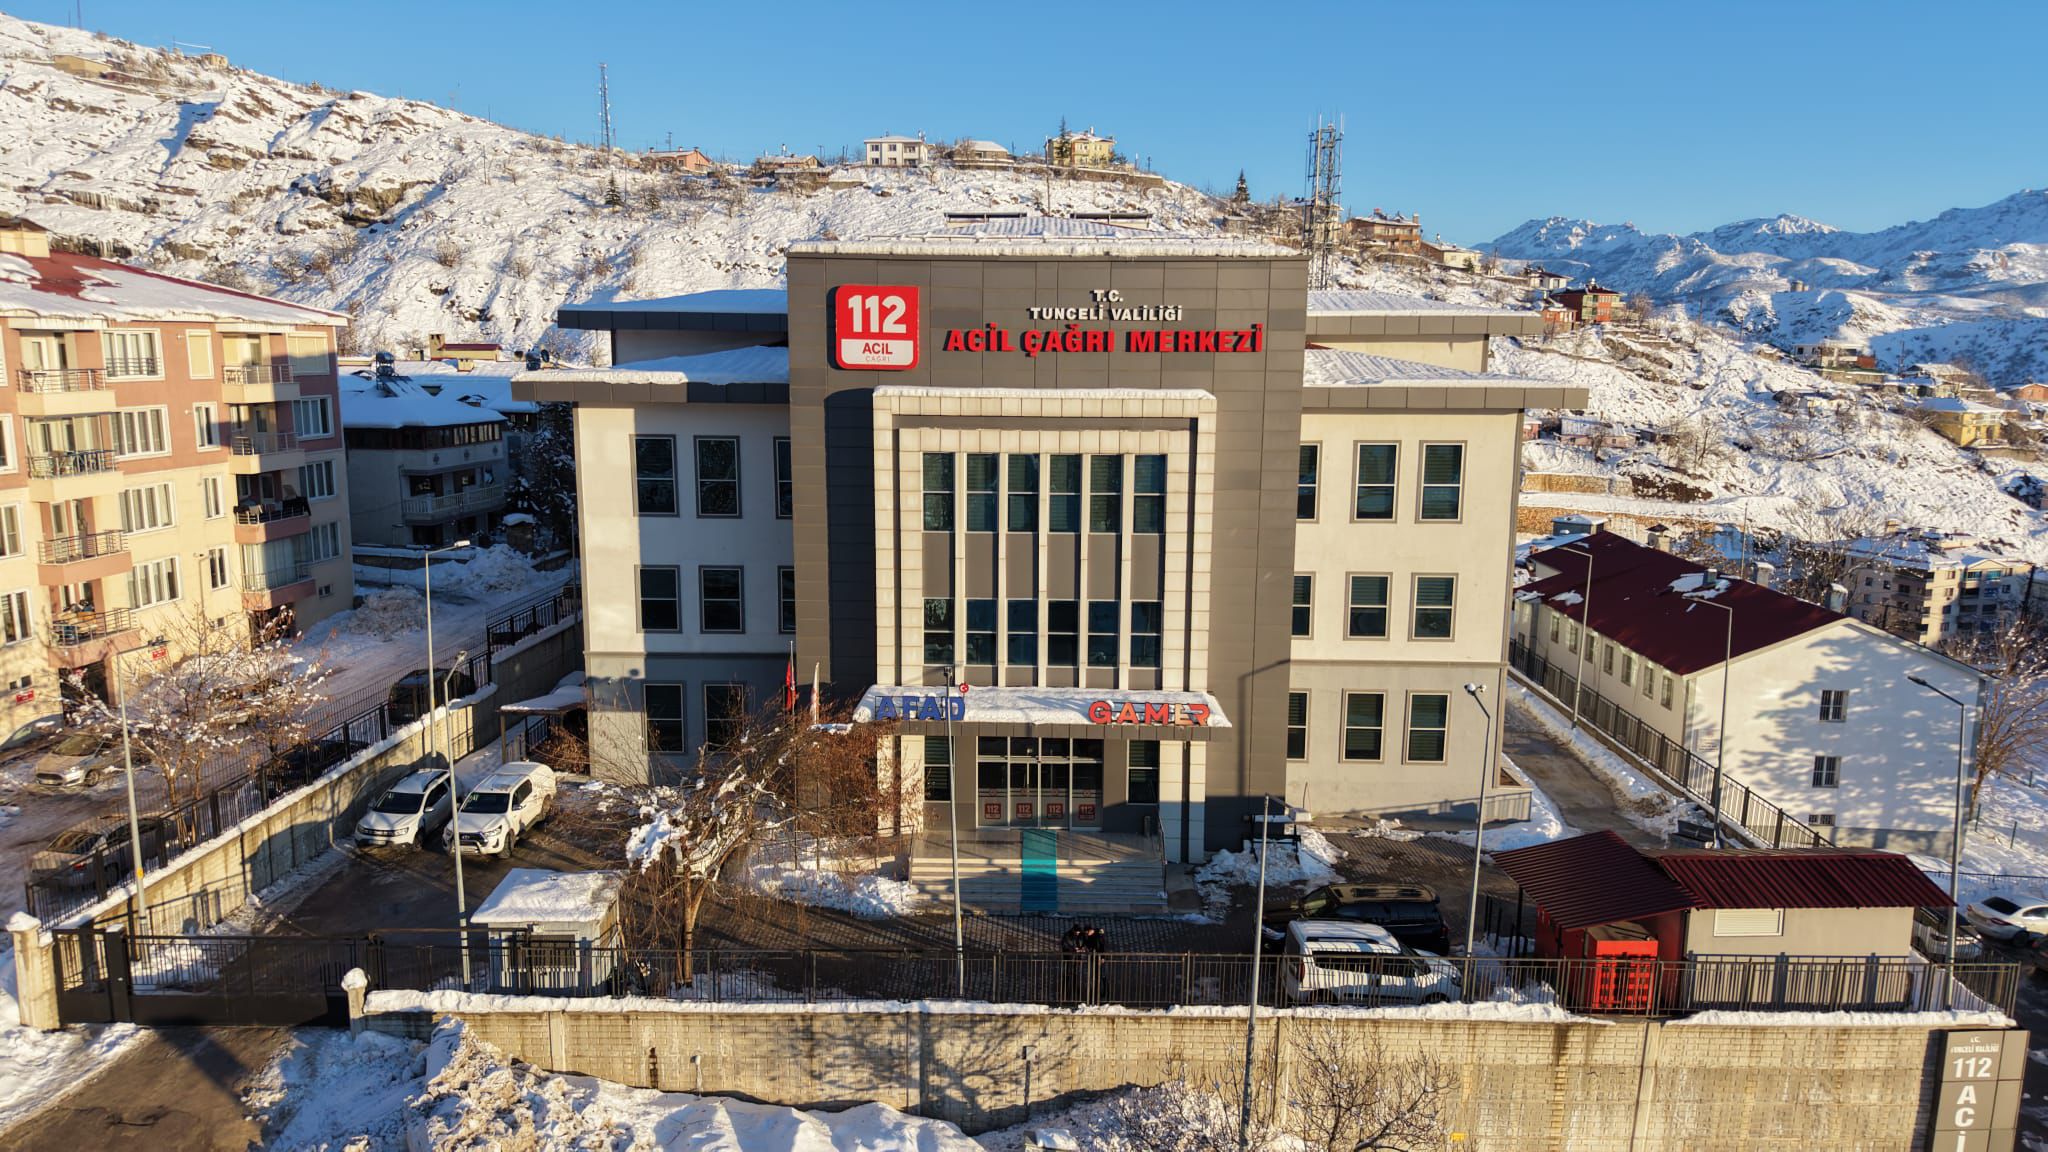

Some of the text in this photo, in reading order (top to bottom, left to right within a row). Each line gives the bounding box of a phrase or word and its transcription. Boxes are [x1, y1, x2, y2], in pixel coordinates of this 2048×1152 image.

[1093, 289, 1124, 302] T.C.
[848, 295, 907, 334] 112
[1030, 305, 1183, 321] TUNCELİ VALİLİĞİ
[946, 321, 1264, 358] ACİL ÇAĞRI MERKEZİ
[862, 343, 893, 355] ACİL
[876, 696, 966, 721] AFAD
[1088, 700, 1211, 726] GAMER
[986, 804, 1000, 814] 112
[1017, 804, 1031, 813] 112
[1048, 804, 1062, 814] 112
[1953, 1057, 1993, 1078] 112
